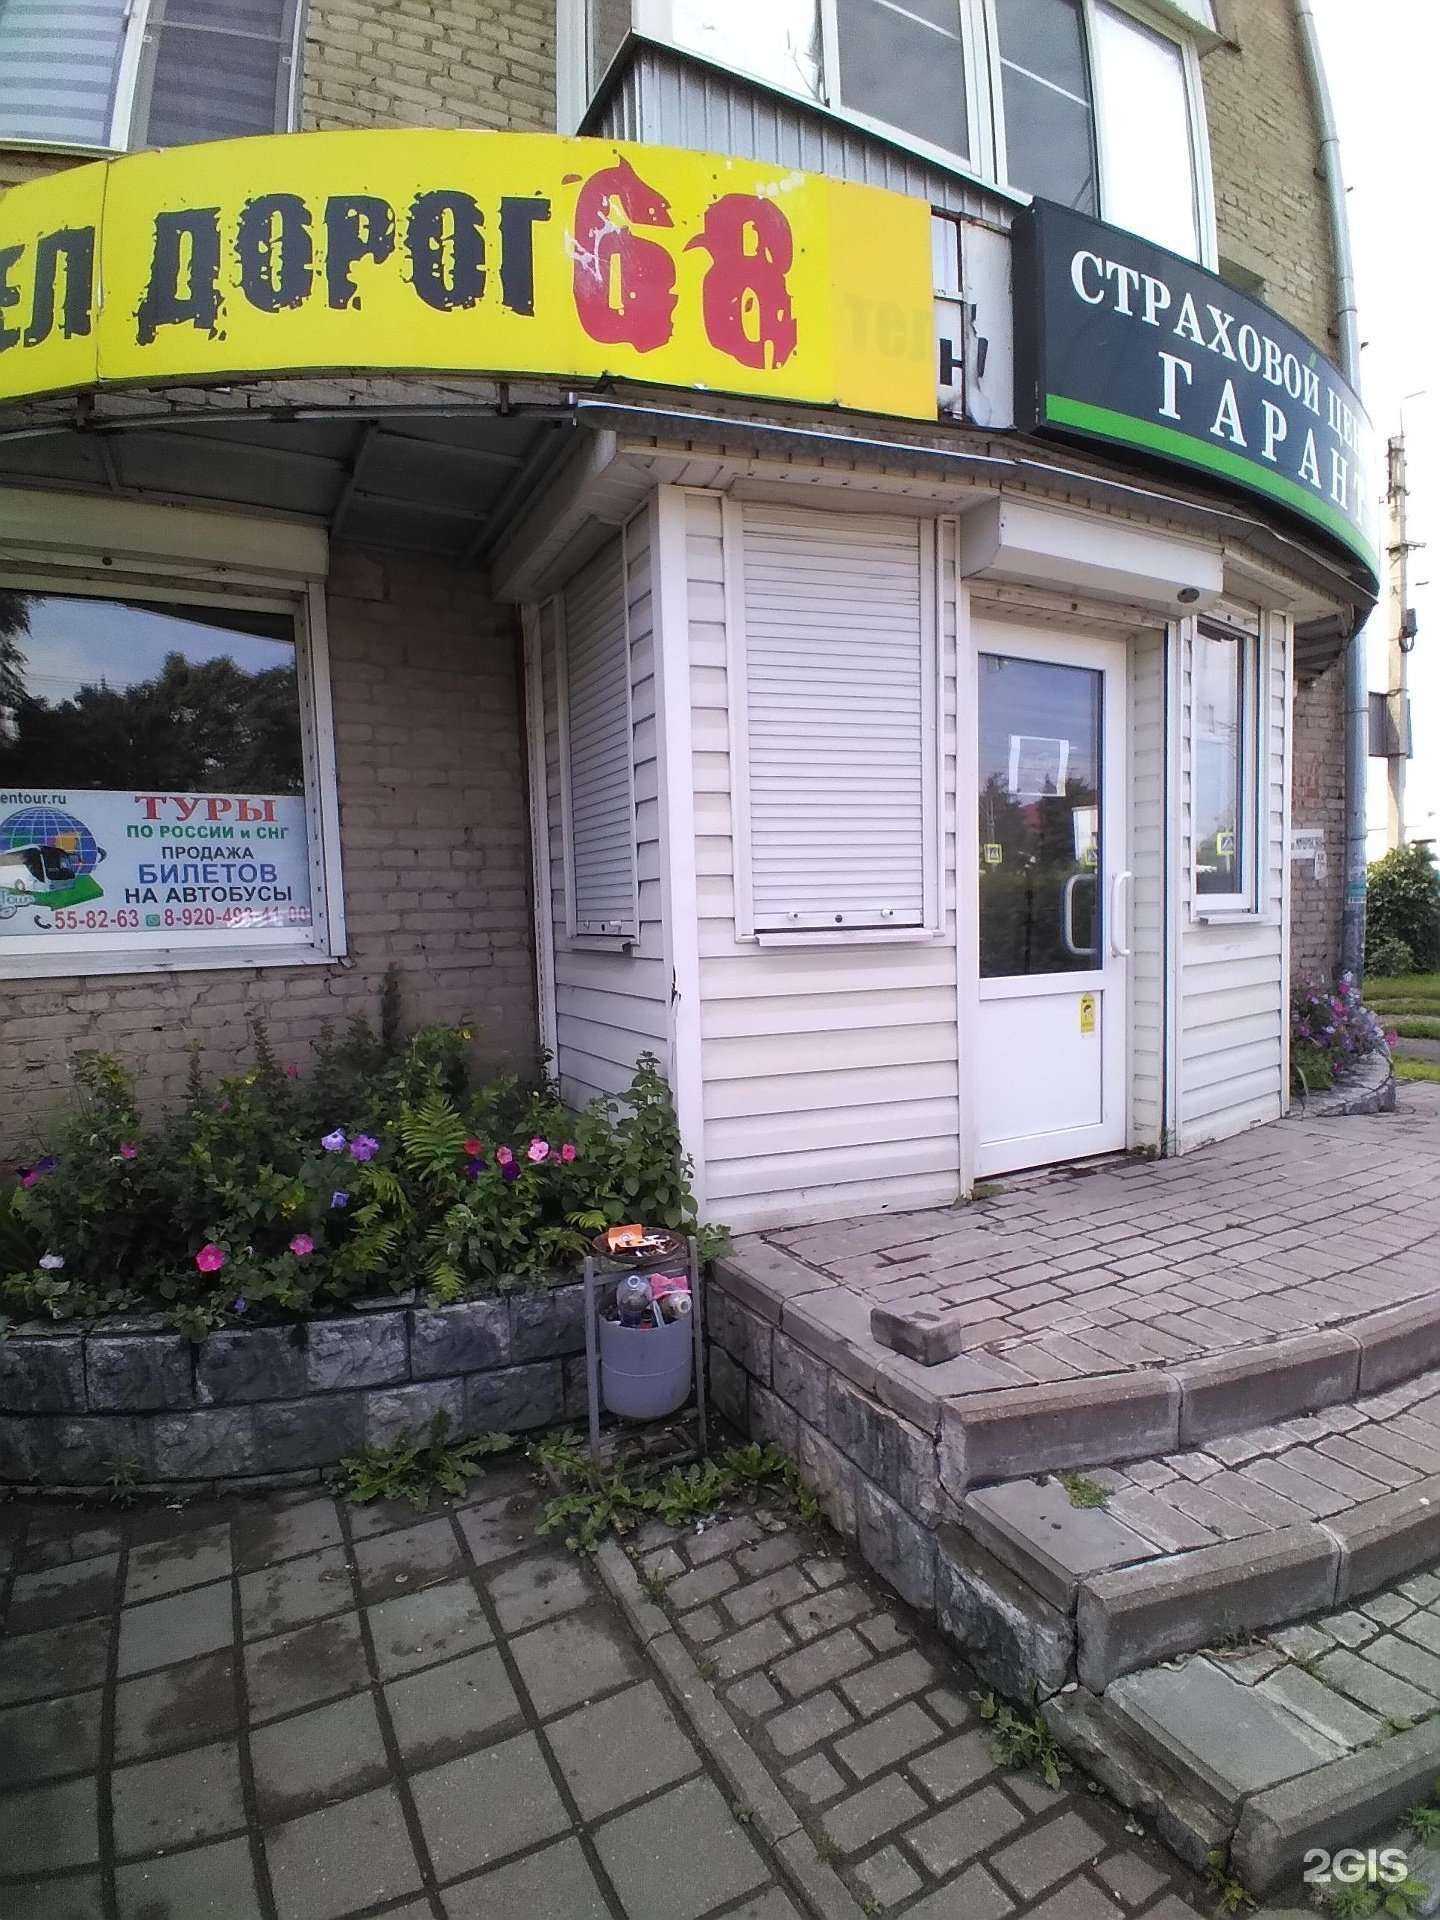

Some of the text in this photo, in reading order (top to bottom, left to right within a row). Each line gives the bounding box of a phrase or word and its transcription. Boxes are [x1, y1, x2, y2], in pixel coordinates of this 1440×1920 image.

[135, 188, 551, 347] ДОРОГ
[1071, 250, 1320, 416] СТРАХОВОЙ
[0, 792, 67, 805] entour.ru
[134, 796, 278, 822] ТУРЫ
[126, 825, 289, 840] ПО РОССИИ и СНГ
[161, 846, 254, 861] ПРОДАЖА
[139, 863, 278, 884] БИЛЕТОВ
[125, 886, 292, 904] НА АВТОБУСЫ
[55, 909, 139, 930] 55-82-63
